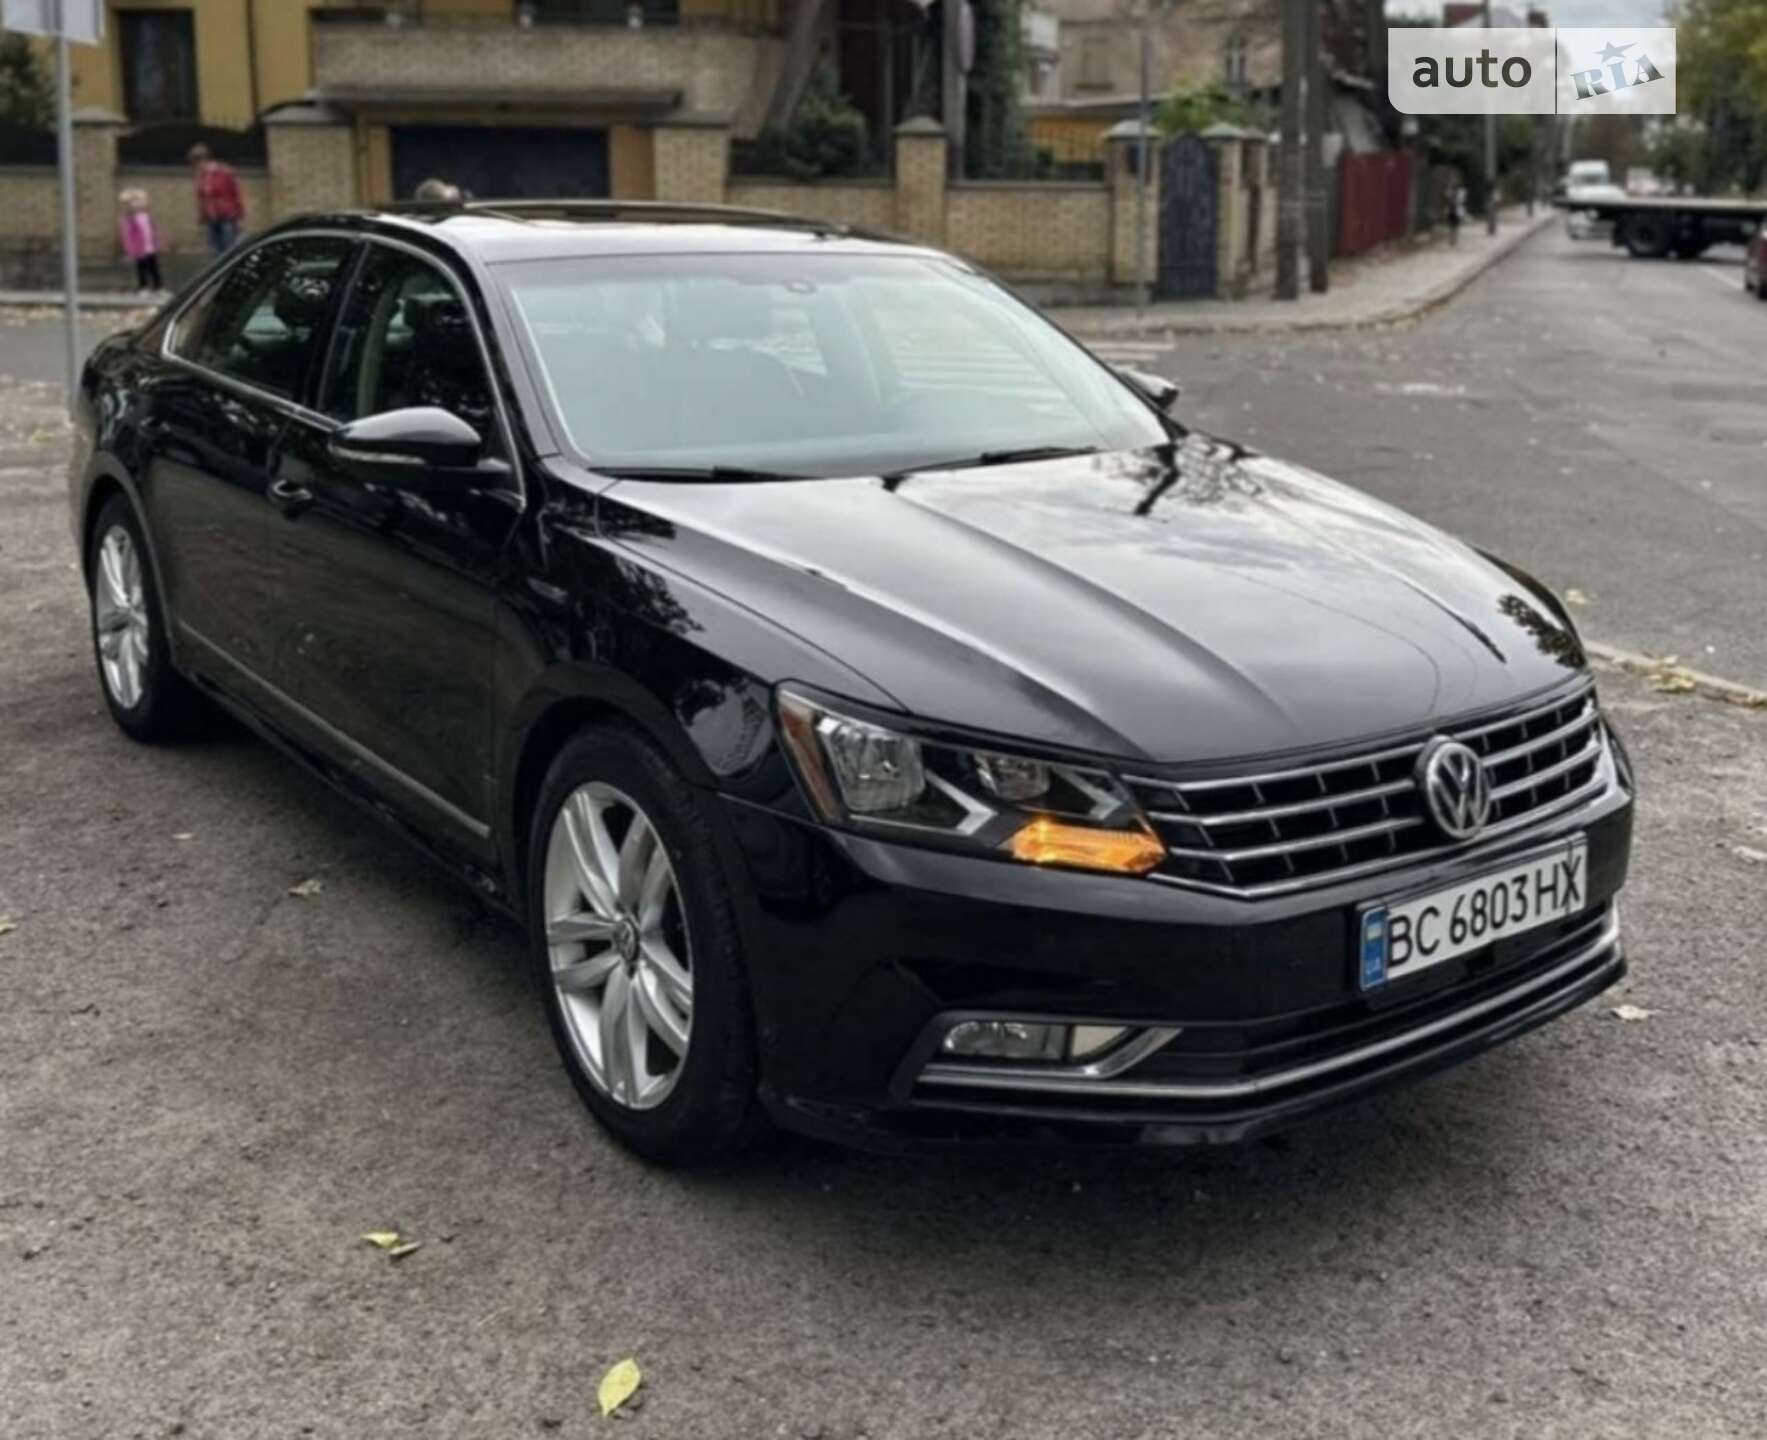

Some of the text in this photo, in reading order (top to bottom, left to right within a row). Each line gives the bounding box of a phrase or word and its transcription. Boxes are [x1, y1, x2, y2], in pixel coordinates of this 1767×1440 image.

[1387, 855, 1582, 966] BC 6803 HX
